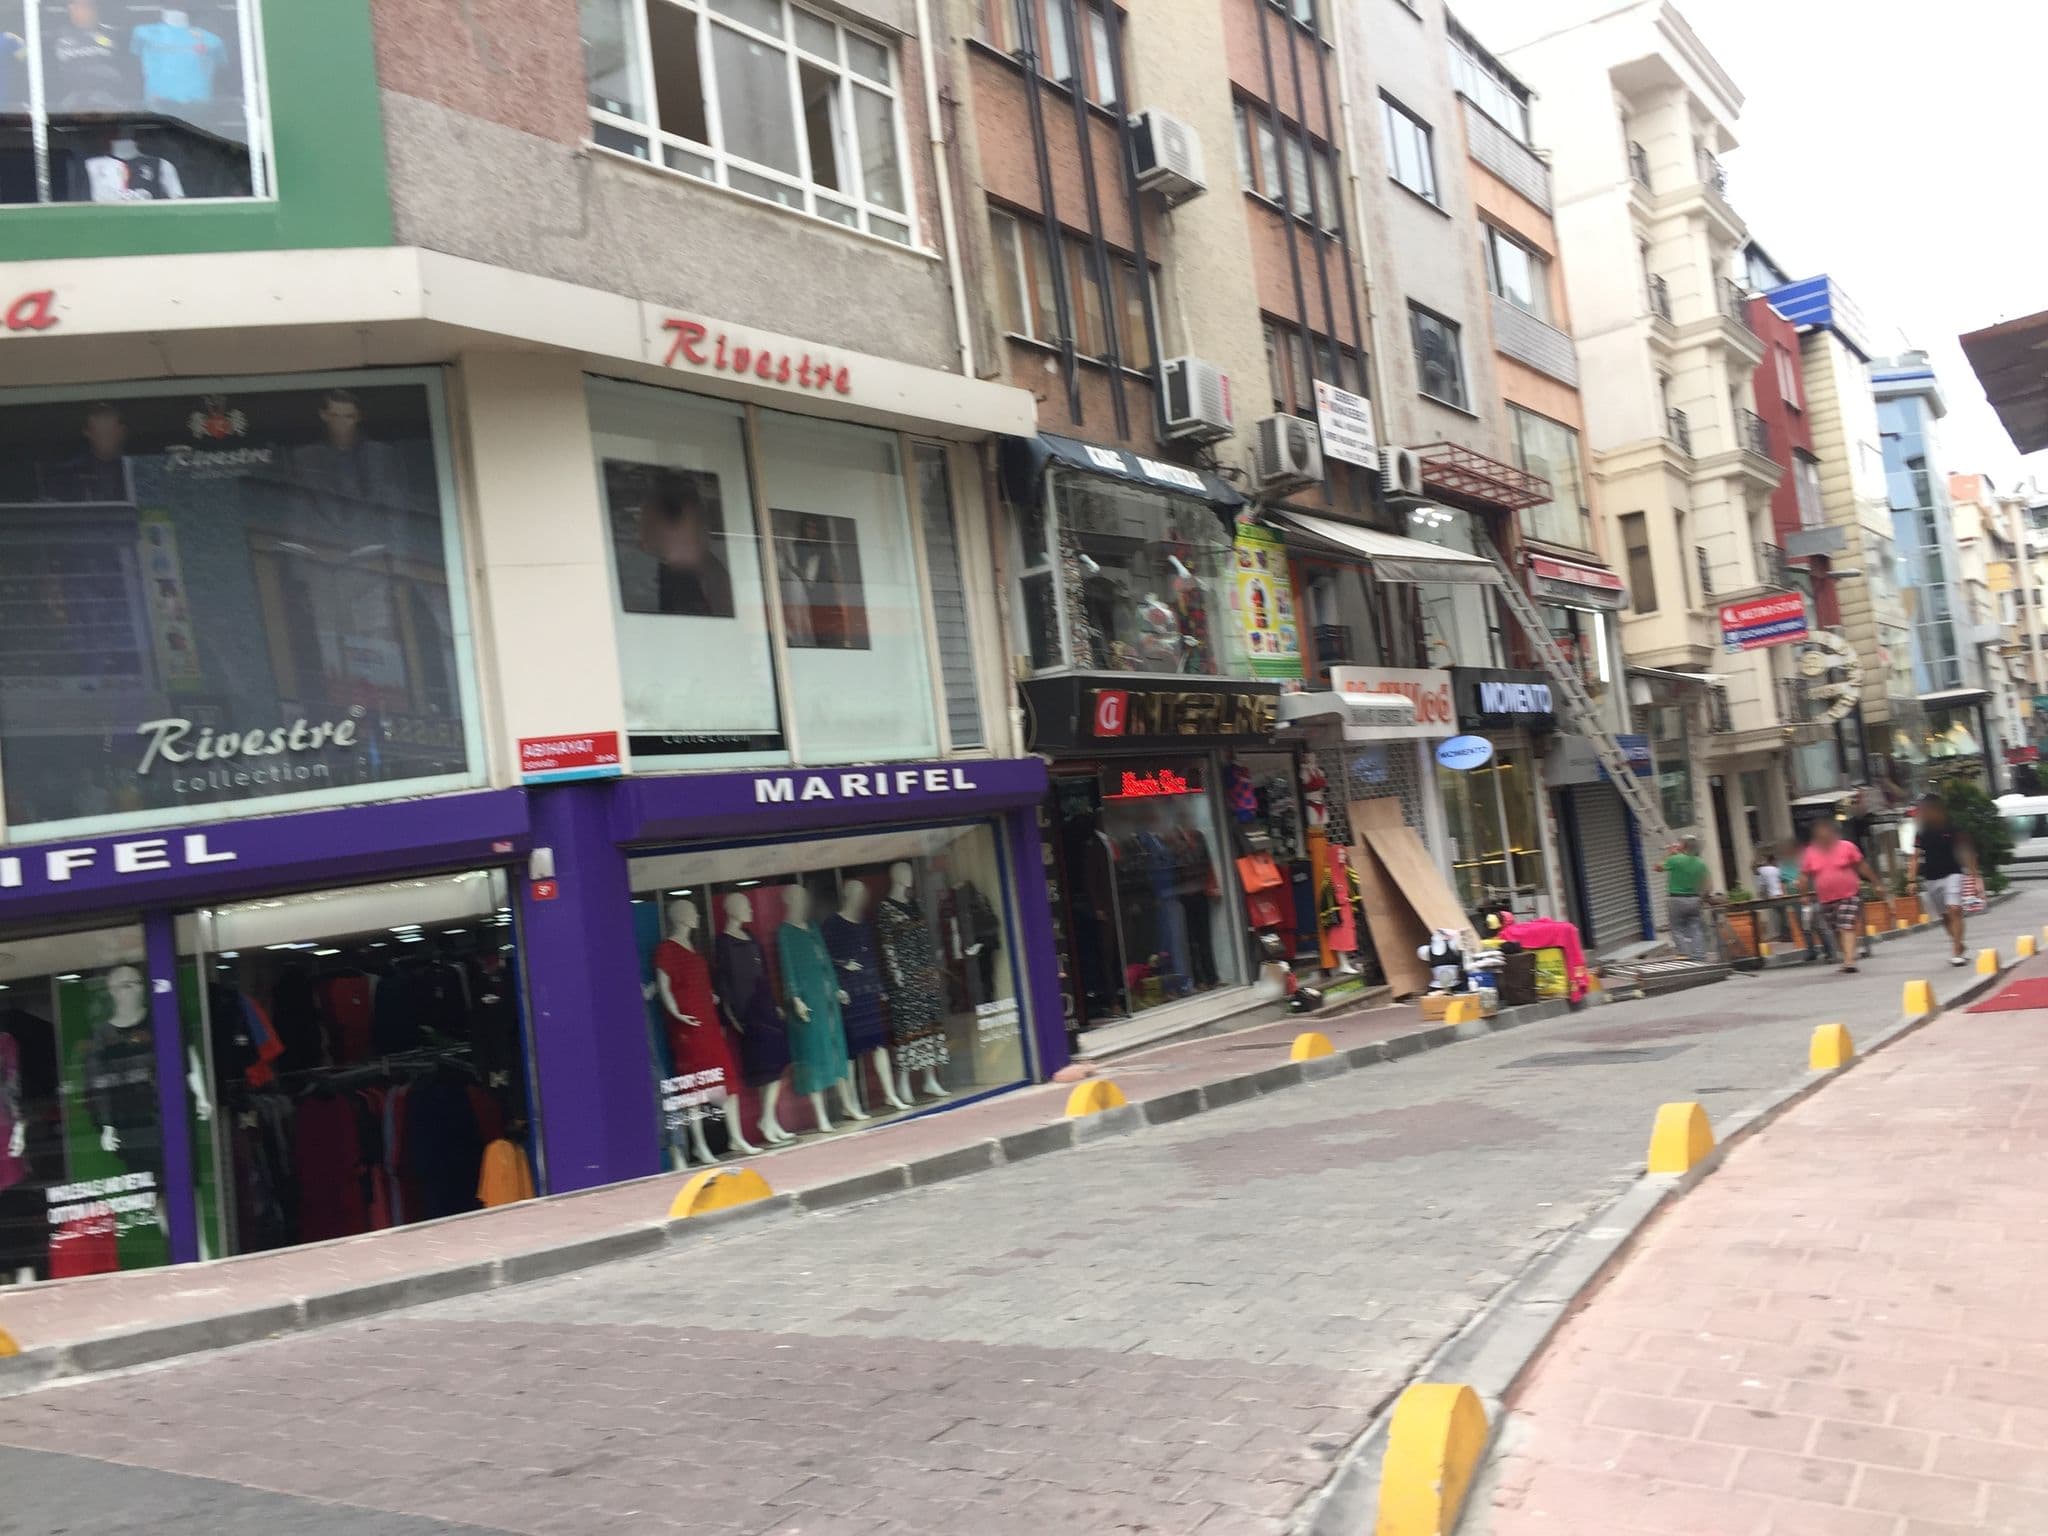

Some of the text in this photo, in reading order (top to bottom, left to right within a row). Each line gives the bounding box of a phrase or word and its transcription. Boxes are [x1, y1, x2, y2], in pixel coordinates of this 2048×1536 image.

[662, 319, 850, 395] Rivestre
[1480, 682, 1553, 714] MOMENTO
[136, 718, 357, 775] Rivestre
[172, 762, 330, 793] collection
[754, 768, 977, 803] MARIFEL
